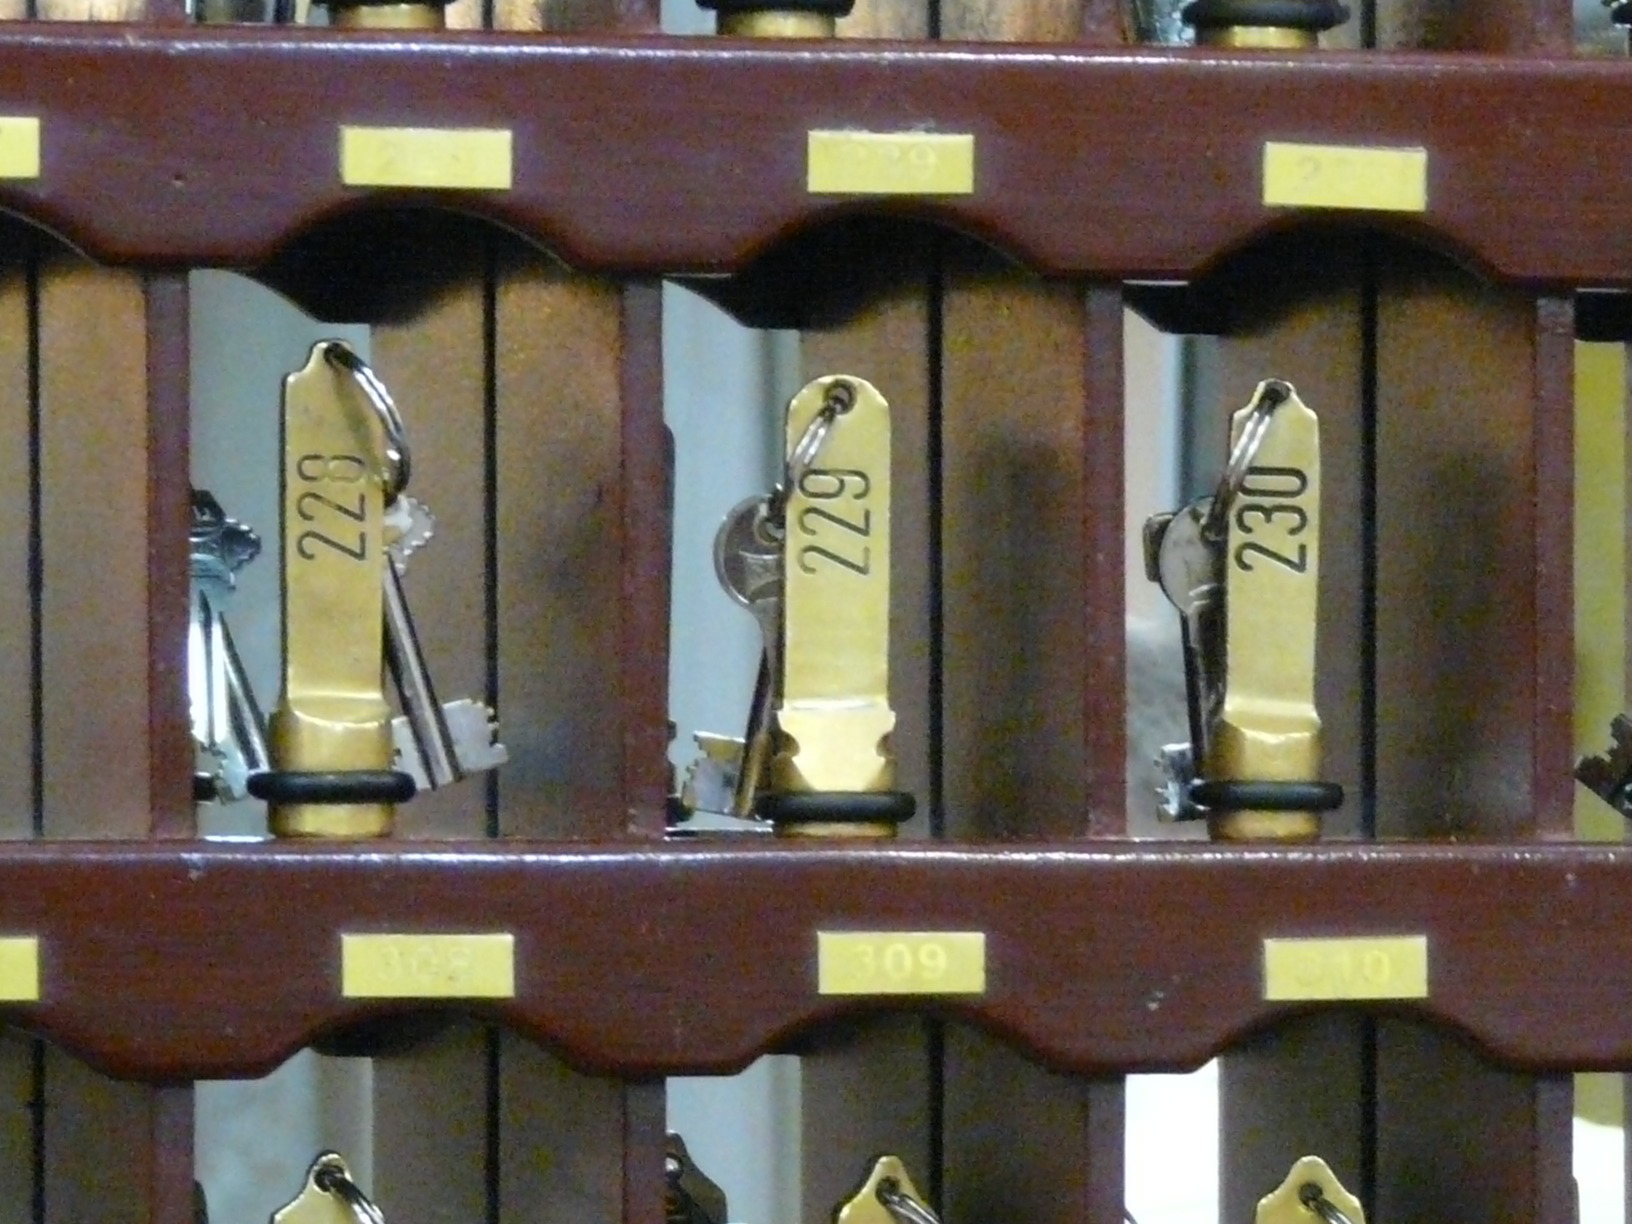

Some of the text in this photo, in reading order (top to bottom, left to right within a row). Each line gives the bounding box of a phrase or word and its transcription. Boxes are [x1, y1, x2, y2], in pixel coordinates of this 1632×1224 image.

[296, 452, 368, 564] 228
[799, 466, 872, 578] 229
[1236, 465, 1310, 575] 230
[856, 942, 948, 981] 309
